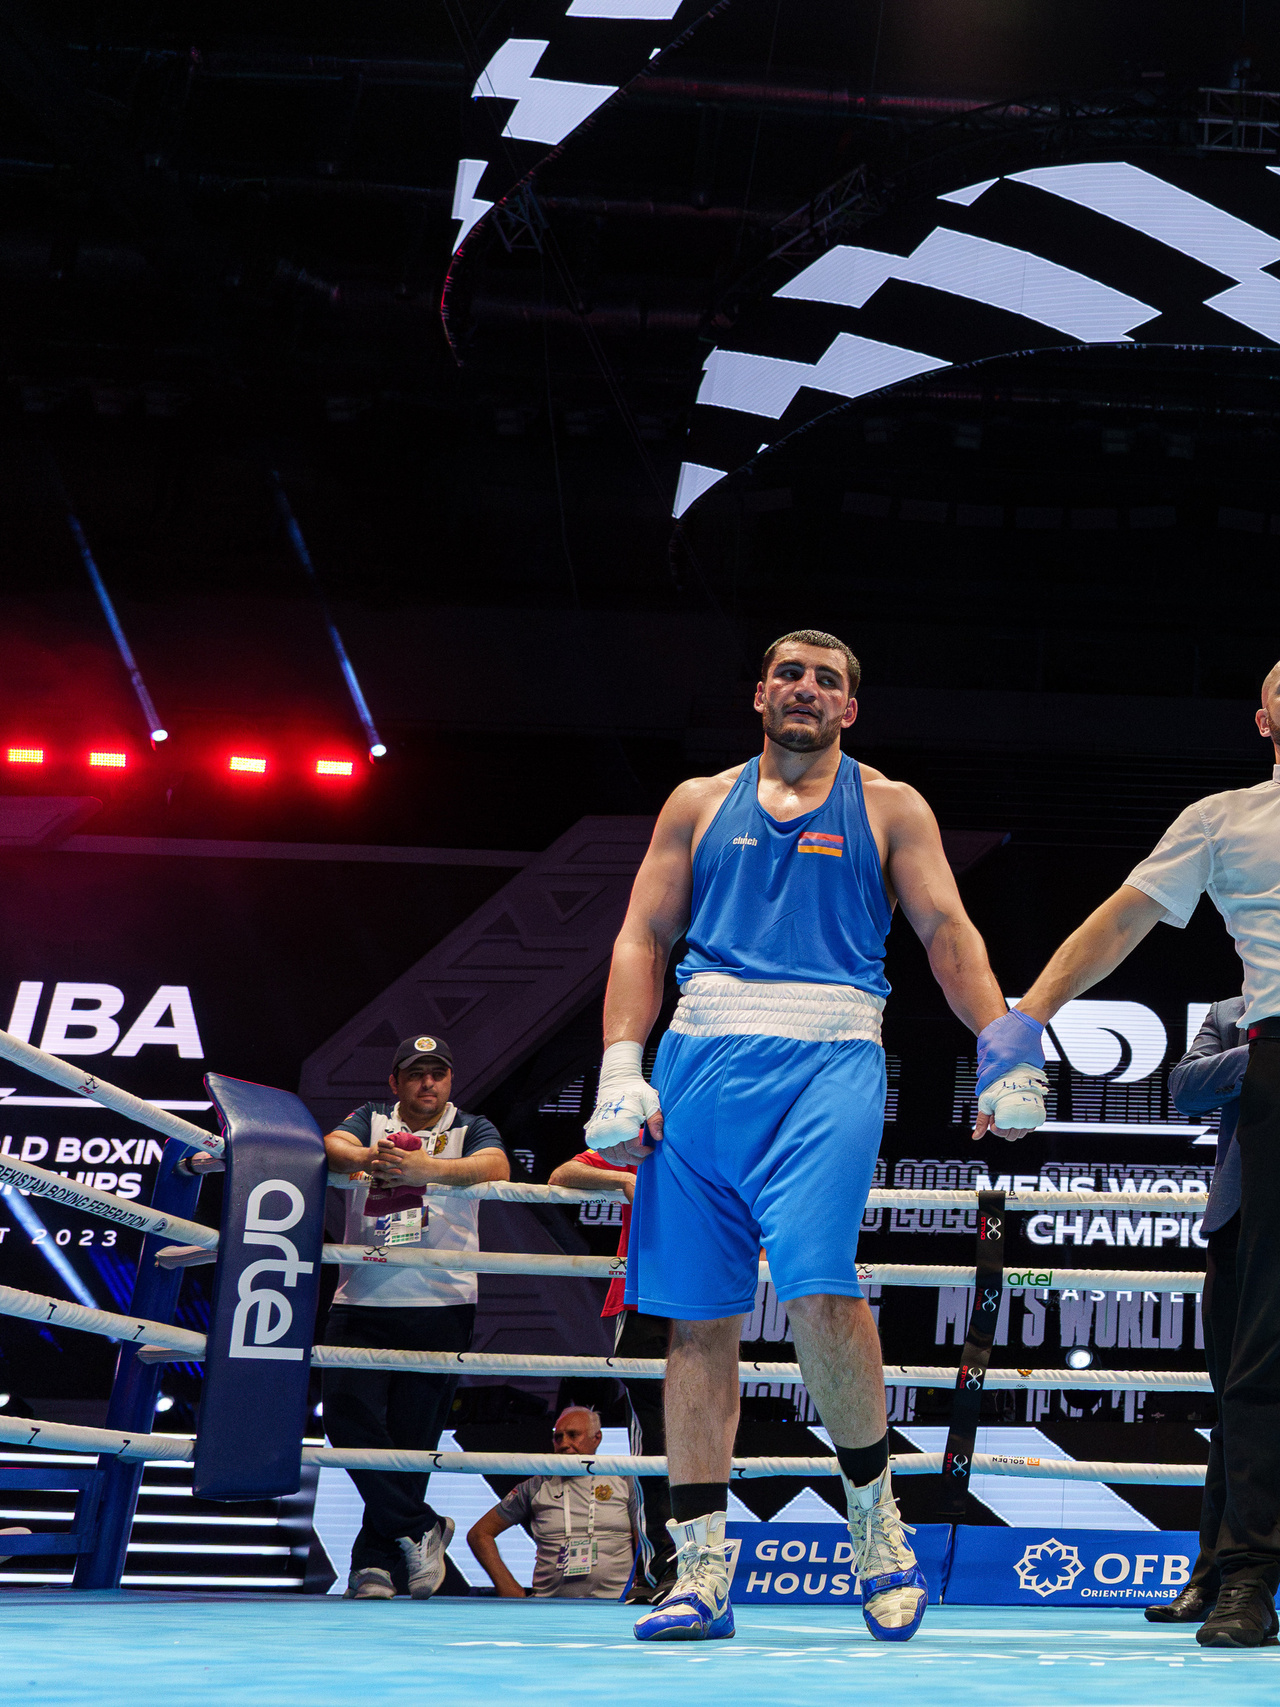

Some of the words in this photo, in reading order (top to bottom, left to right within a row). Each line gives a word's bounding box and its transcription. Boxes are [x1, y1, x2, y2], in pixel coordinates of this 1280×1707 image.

[8, 980, 204, 1059] IBA
[44, 1185, 90, 1207] BOXING
[84, 1199, 150, 1229] FEDERATION
[31, 1228, 118, 1247] 2023
[229, 1179, 314, 1361] artel
[1007, 1270, 1053, 1287] artel
[1094, 1553, 1191, 1585] OFB
